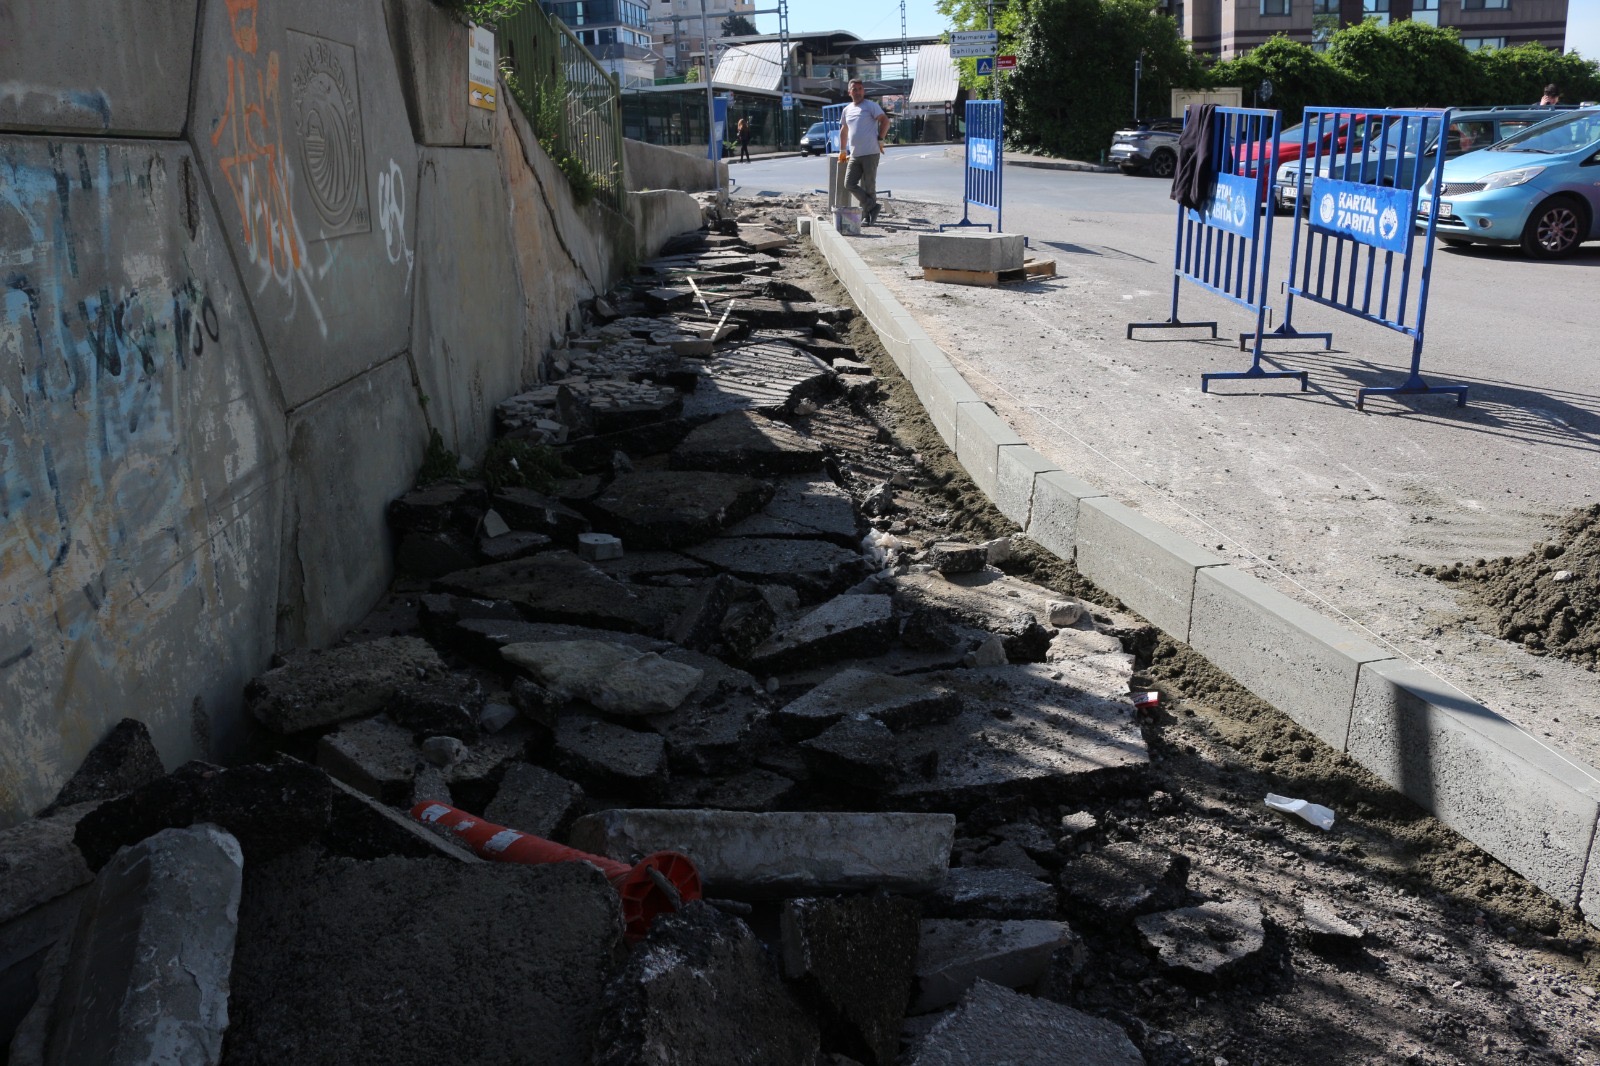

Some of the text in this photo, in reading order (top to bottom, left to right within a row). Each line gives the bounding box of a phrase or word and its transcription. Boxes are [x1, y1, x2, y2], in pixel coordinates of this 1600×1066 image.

[952, 47, 987, 55] Sahilyolu
[1338, 192, 1379, 215] KARTAL
[1337, 209, 1376, 236] ZABITA
